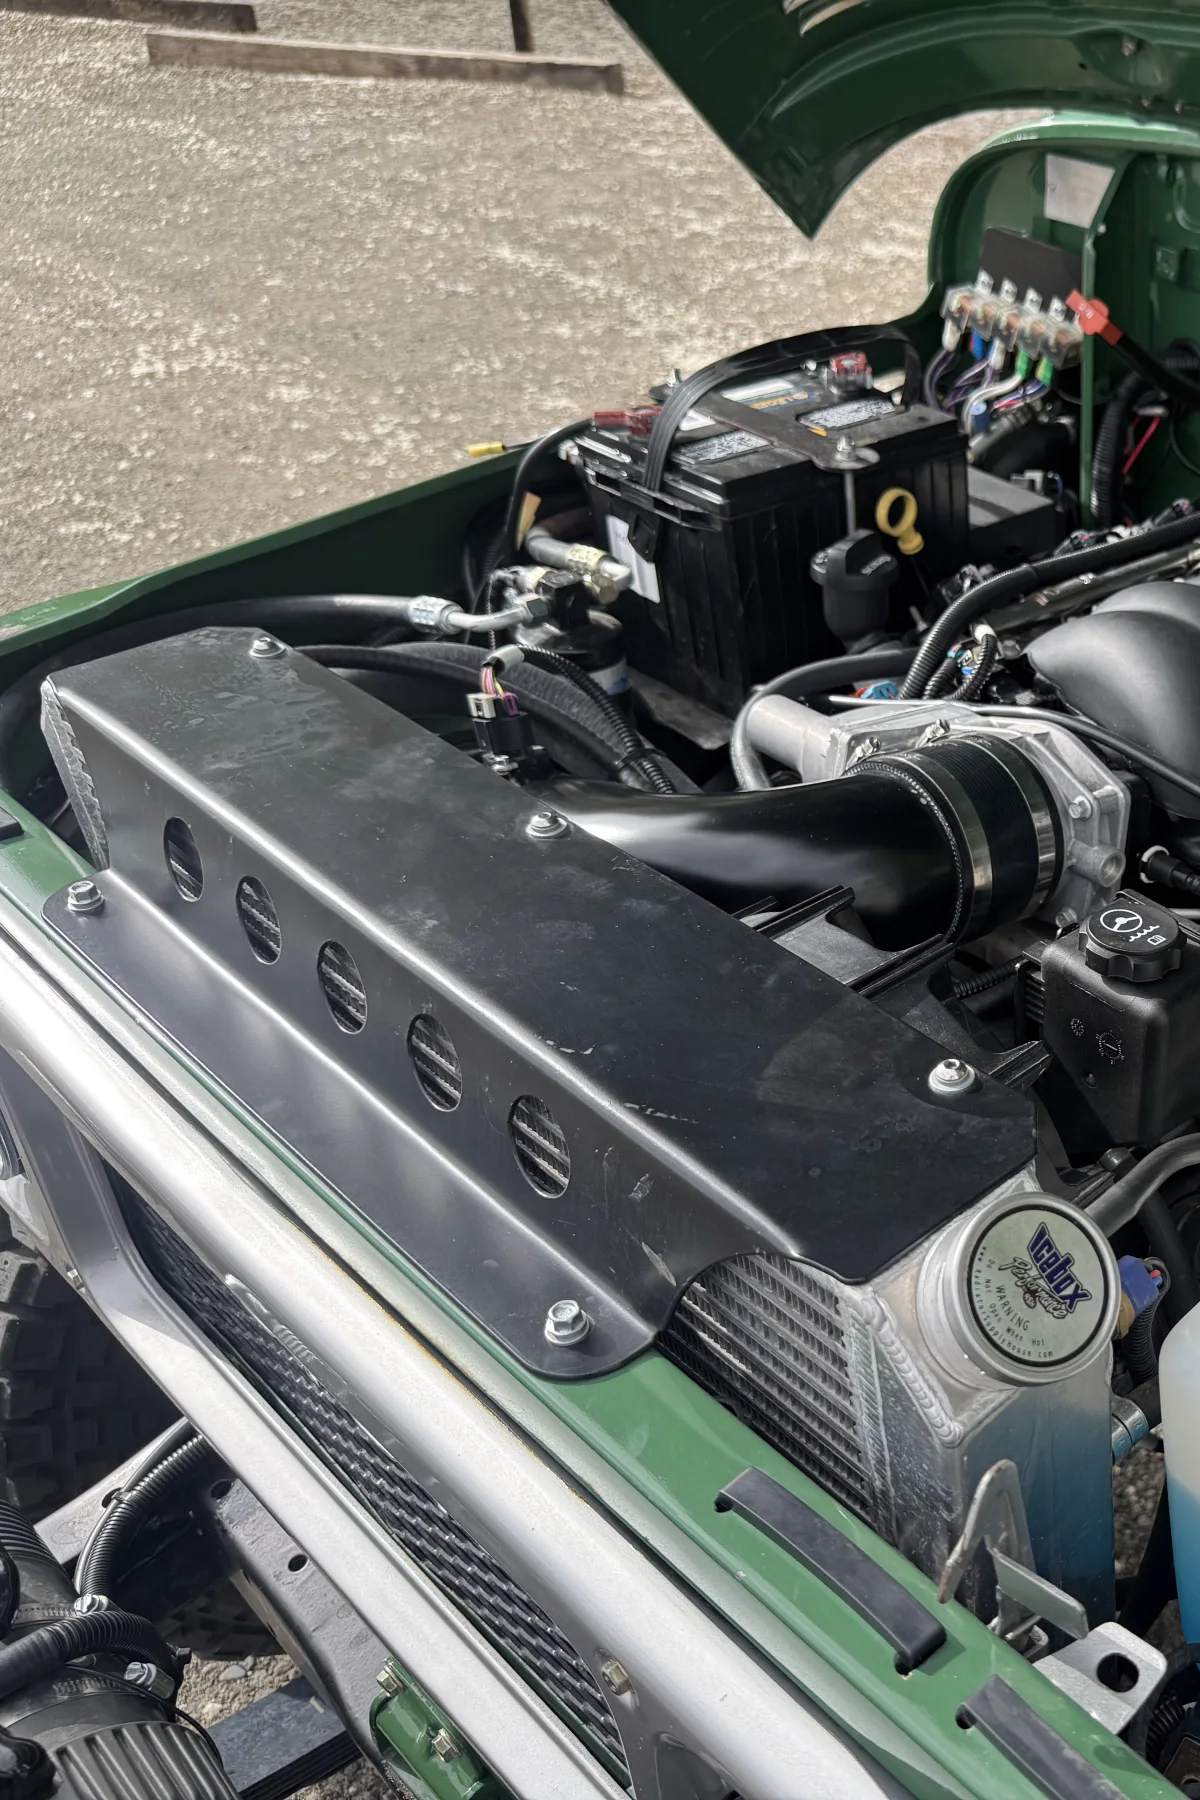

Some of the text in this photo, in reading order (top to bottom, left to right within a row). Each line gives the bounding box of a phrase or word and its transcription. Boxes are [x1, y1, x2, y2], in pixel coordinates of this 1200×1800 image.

[987, 1259, 995, 1268] Do
[998, 1256, 1068, 1319] Performance
[990, 1303, 1002, 1323] Open
[996, 1285, 1030, 1331] WARNING
[1006, 1326, 1024, 1341] When
[1032, 1338, 1045, 1346] Hot
